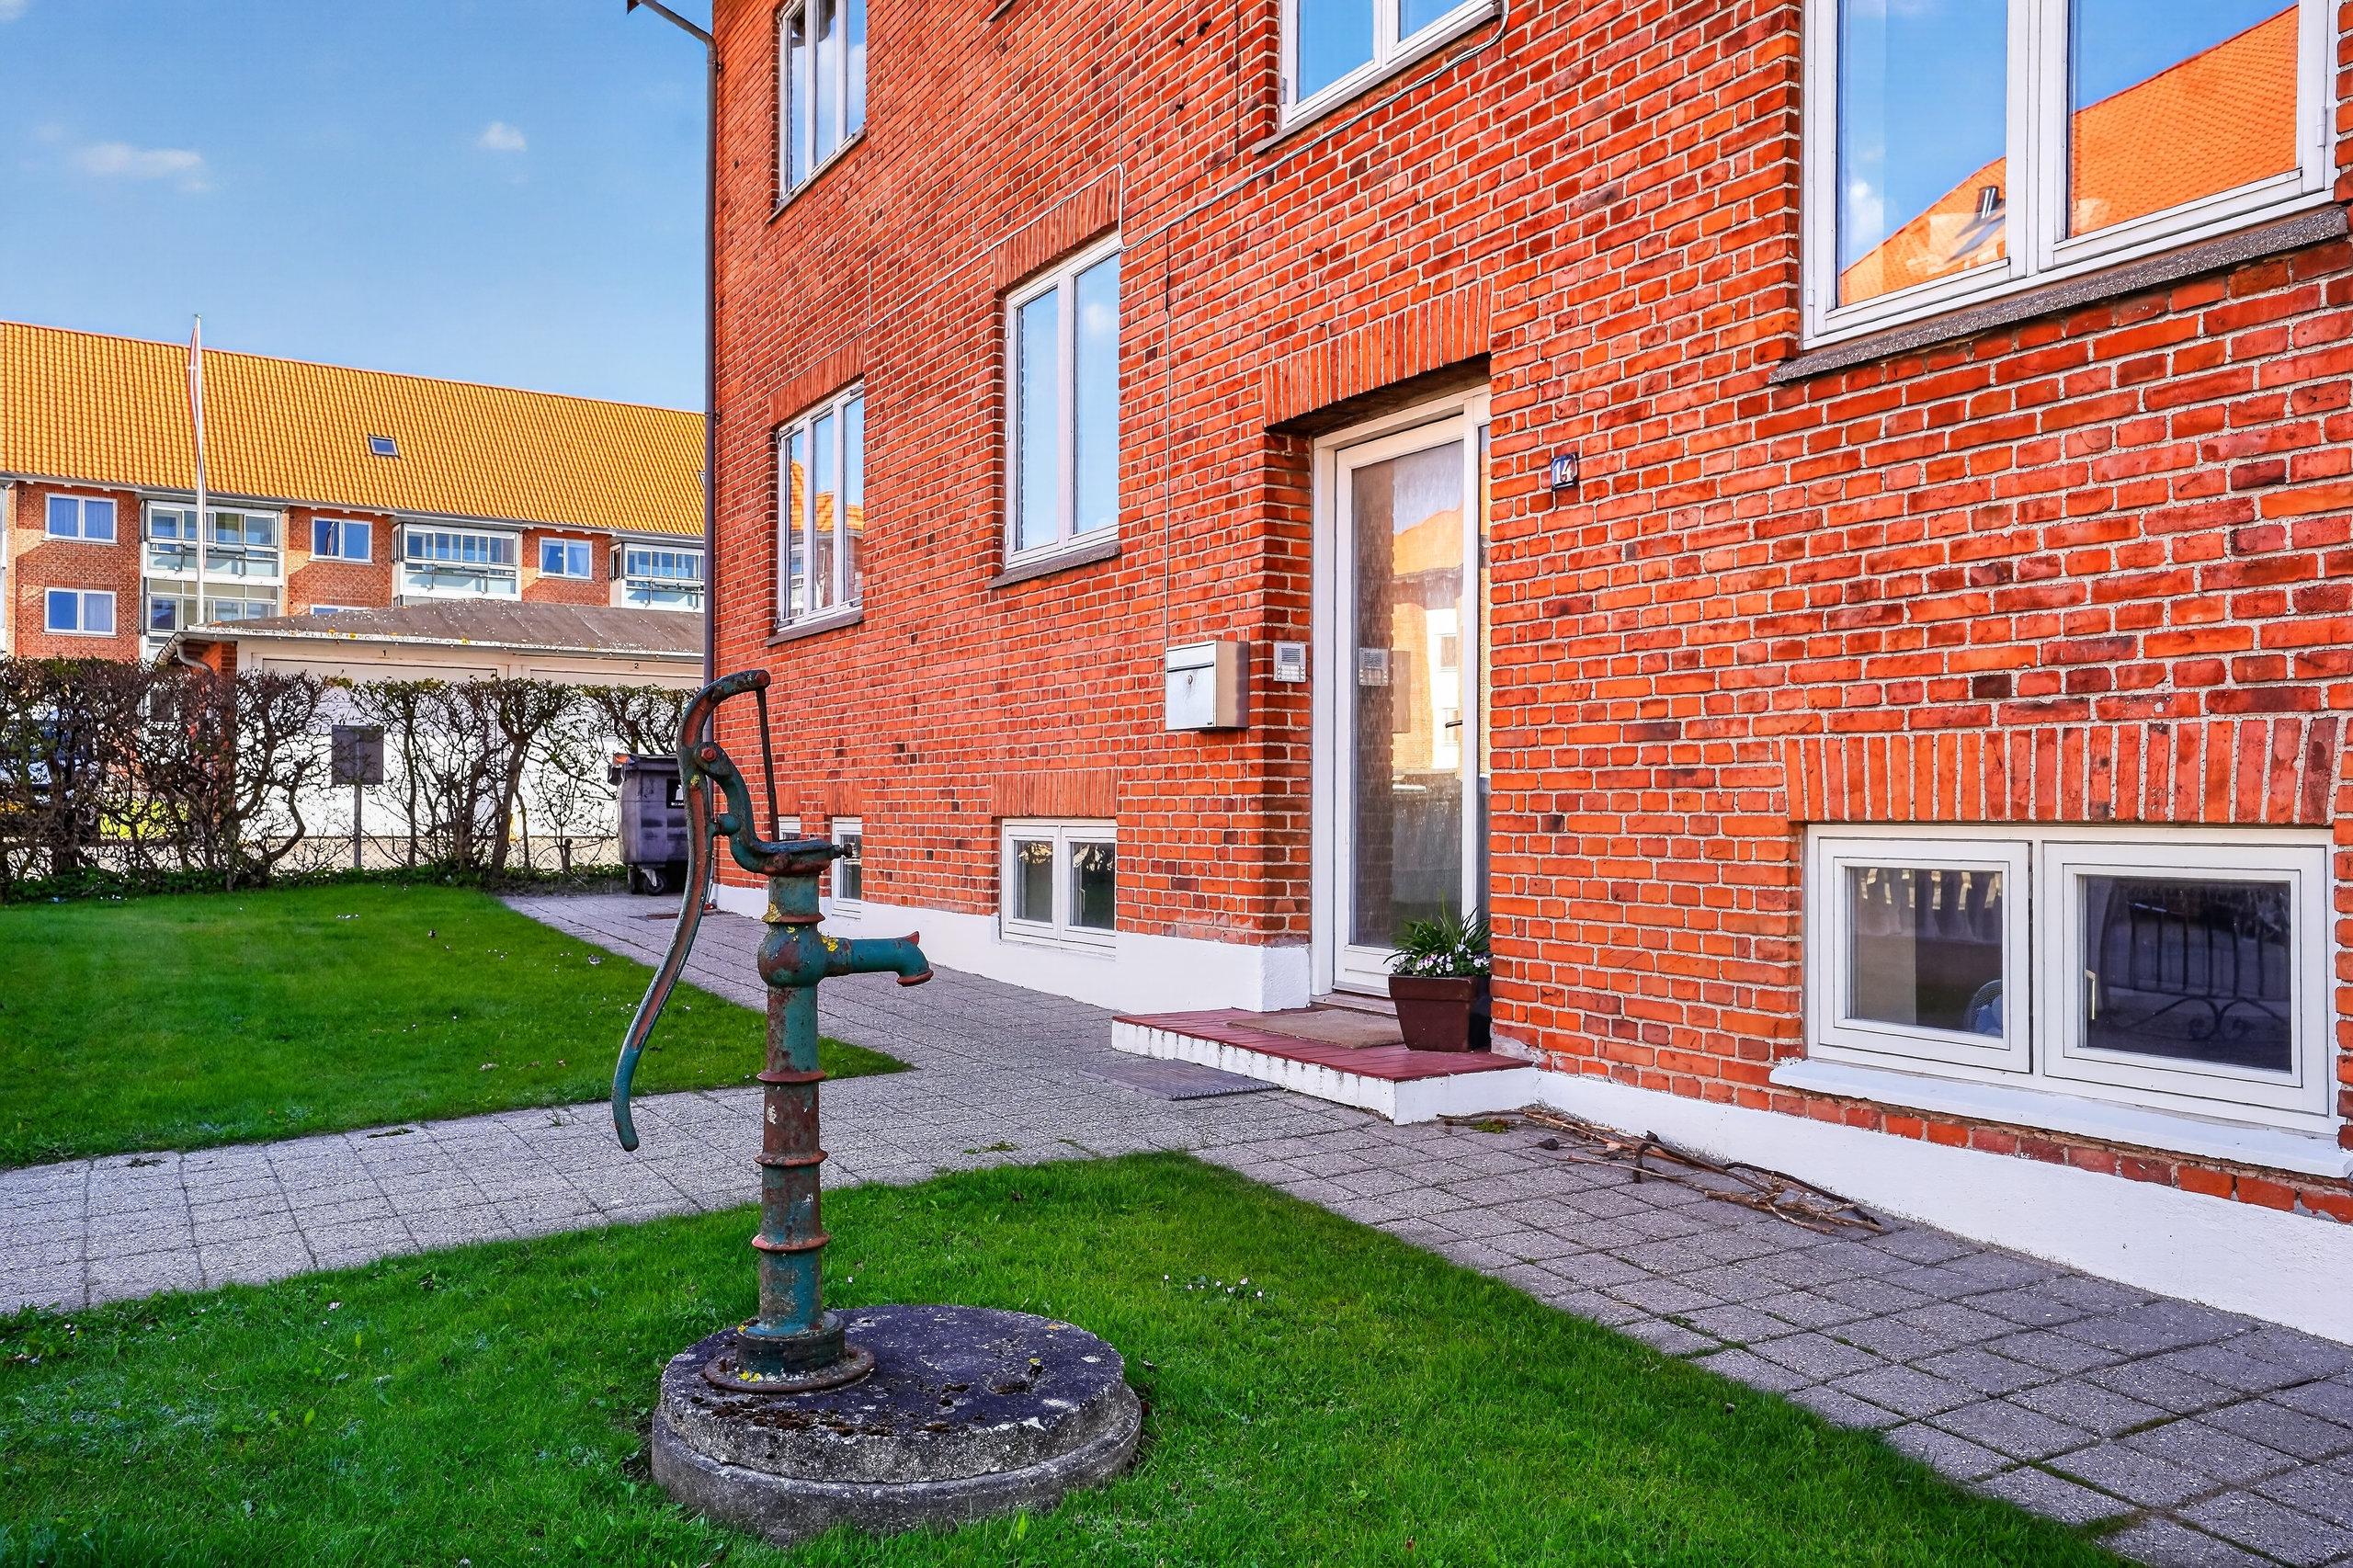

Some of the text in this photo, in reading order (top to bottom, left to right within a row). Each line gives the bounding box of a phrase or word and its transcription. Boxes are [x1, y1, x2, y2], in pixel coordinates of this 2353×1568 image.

[1553, 460, 1572, 484] 14
[382, 649, 387, 657] 1
[634, 662, 640, 670] 2
